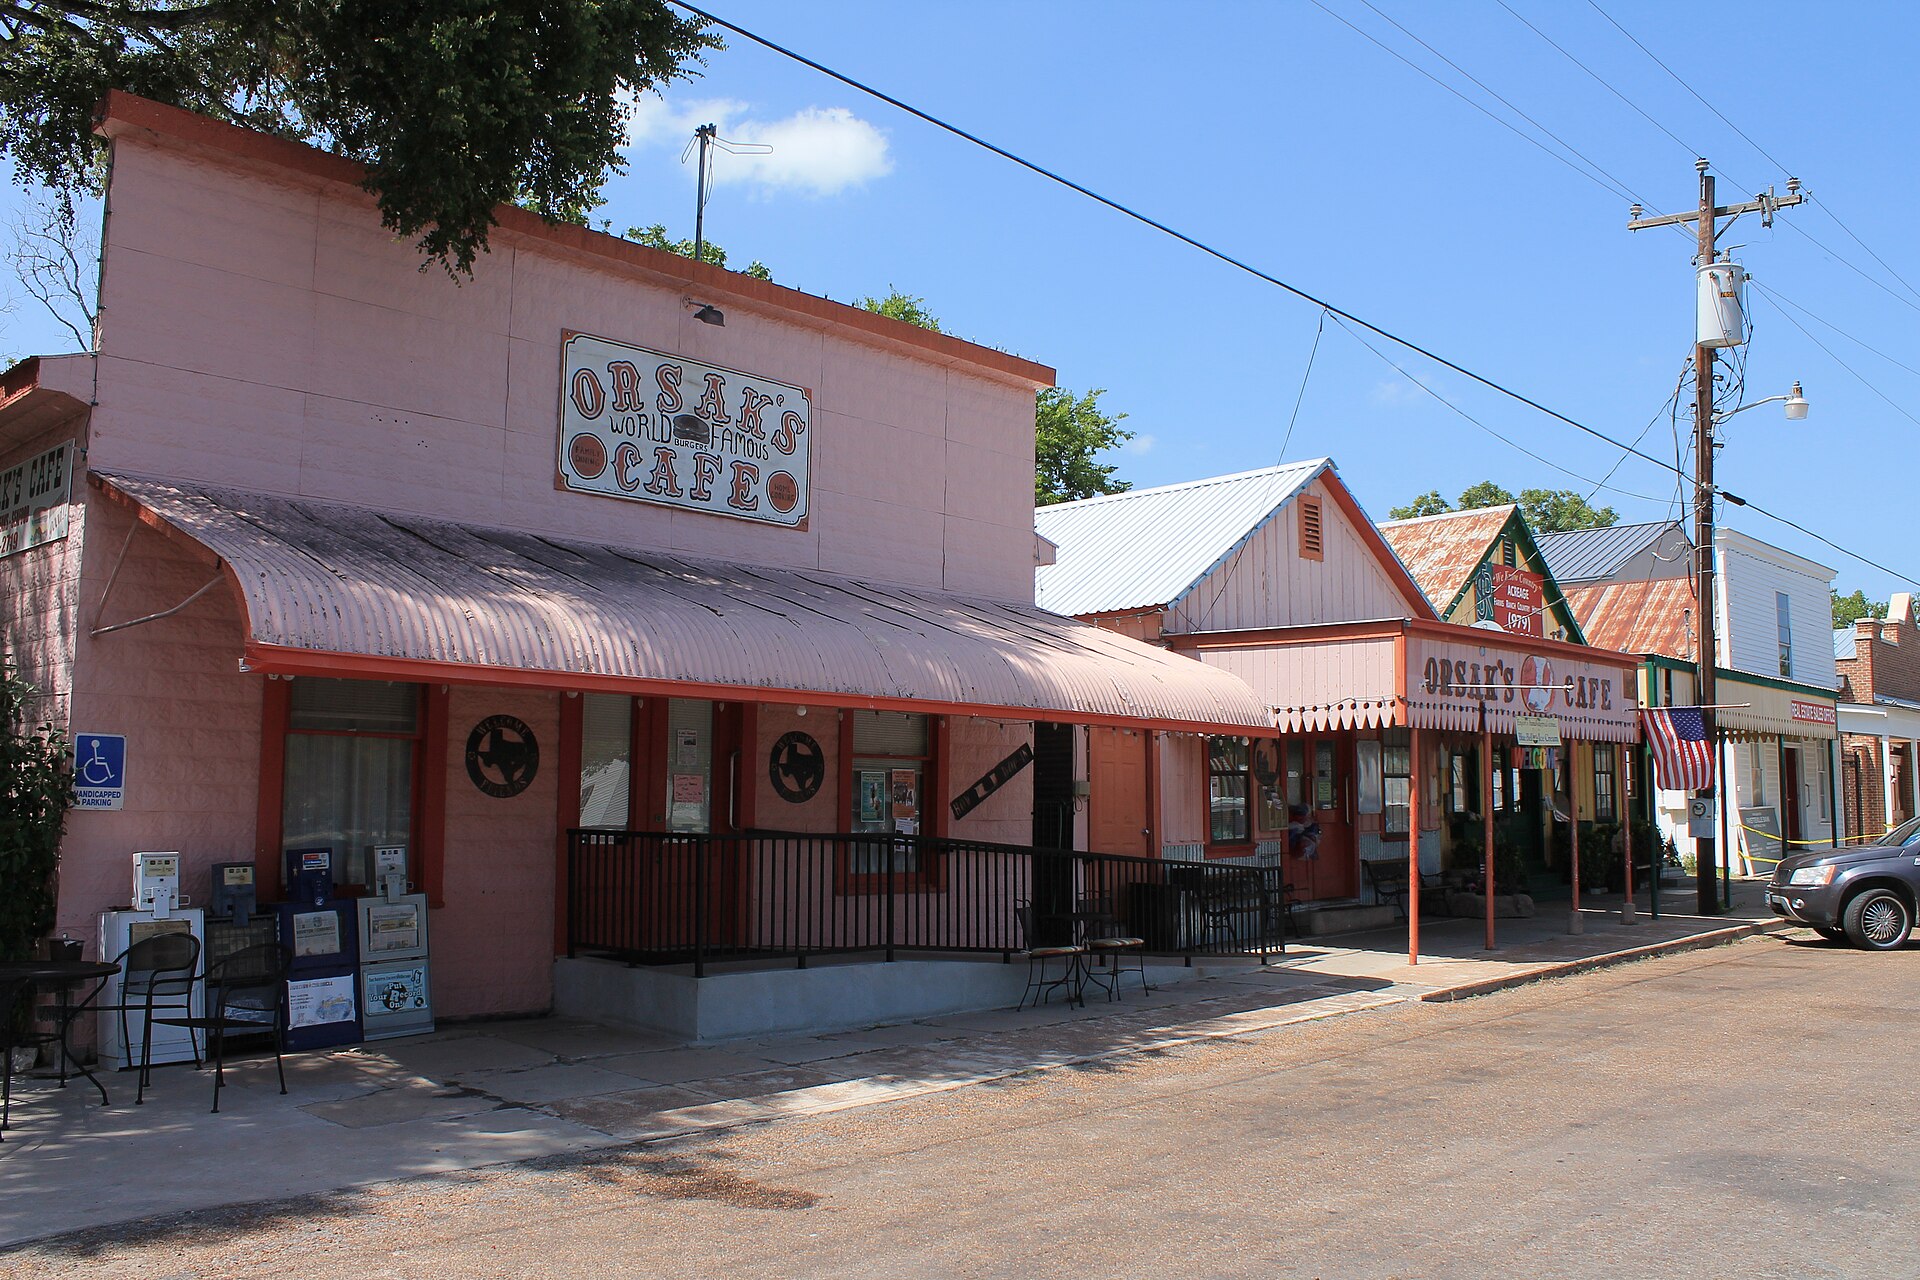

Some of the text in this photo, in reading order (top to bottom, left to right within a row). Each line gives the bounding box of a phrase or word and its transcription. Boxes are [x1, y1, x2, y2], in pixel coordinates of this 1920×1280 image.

[570, 360, 806, 455] ORSAK'S
[609, 413, 769, 460] WORLD FAMOUS
[575, 445, 600, 457] FAMILY
[674, 438, 708, 452] BURGERS
[575, 456, 600, 467] DINING
[0, 446, 65, 510] K'S CAFE
[611, 441, 760, 511] CAFE
[1507, 584, 1530, 600] ACREAGE
[1508, 612, 1531, 633] (979)
[1424, 657, 1611, 711] ORSAK'S CAFE
[74, 790, 122, 799] HANDICAPPED
[81, 799, 112, 807] PARKING
[388, 982, 403, 990] Put
[368, 989, 422, 1003] Your Record
[389, 1000, 404, 1008] On!
